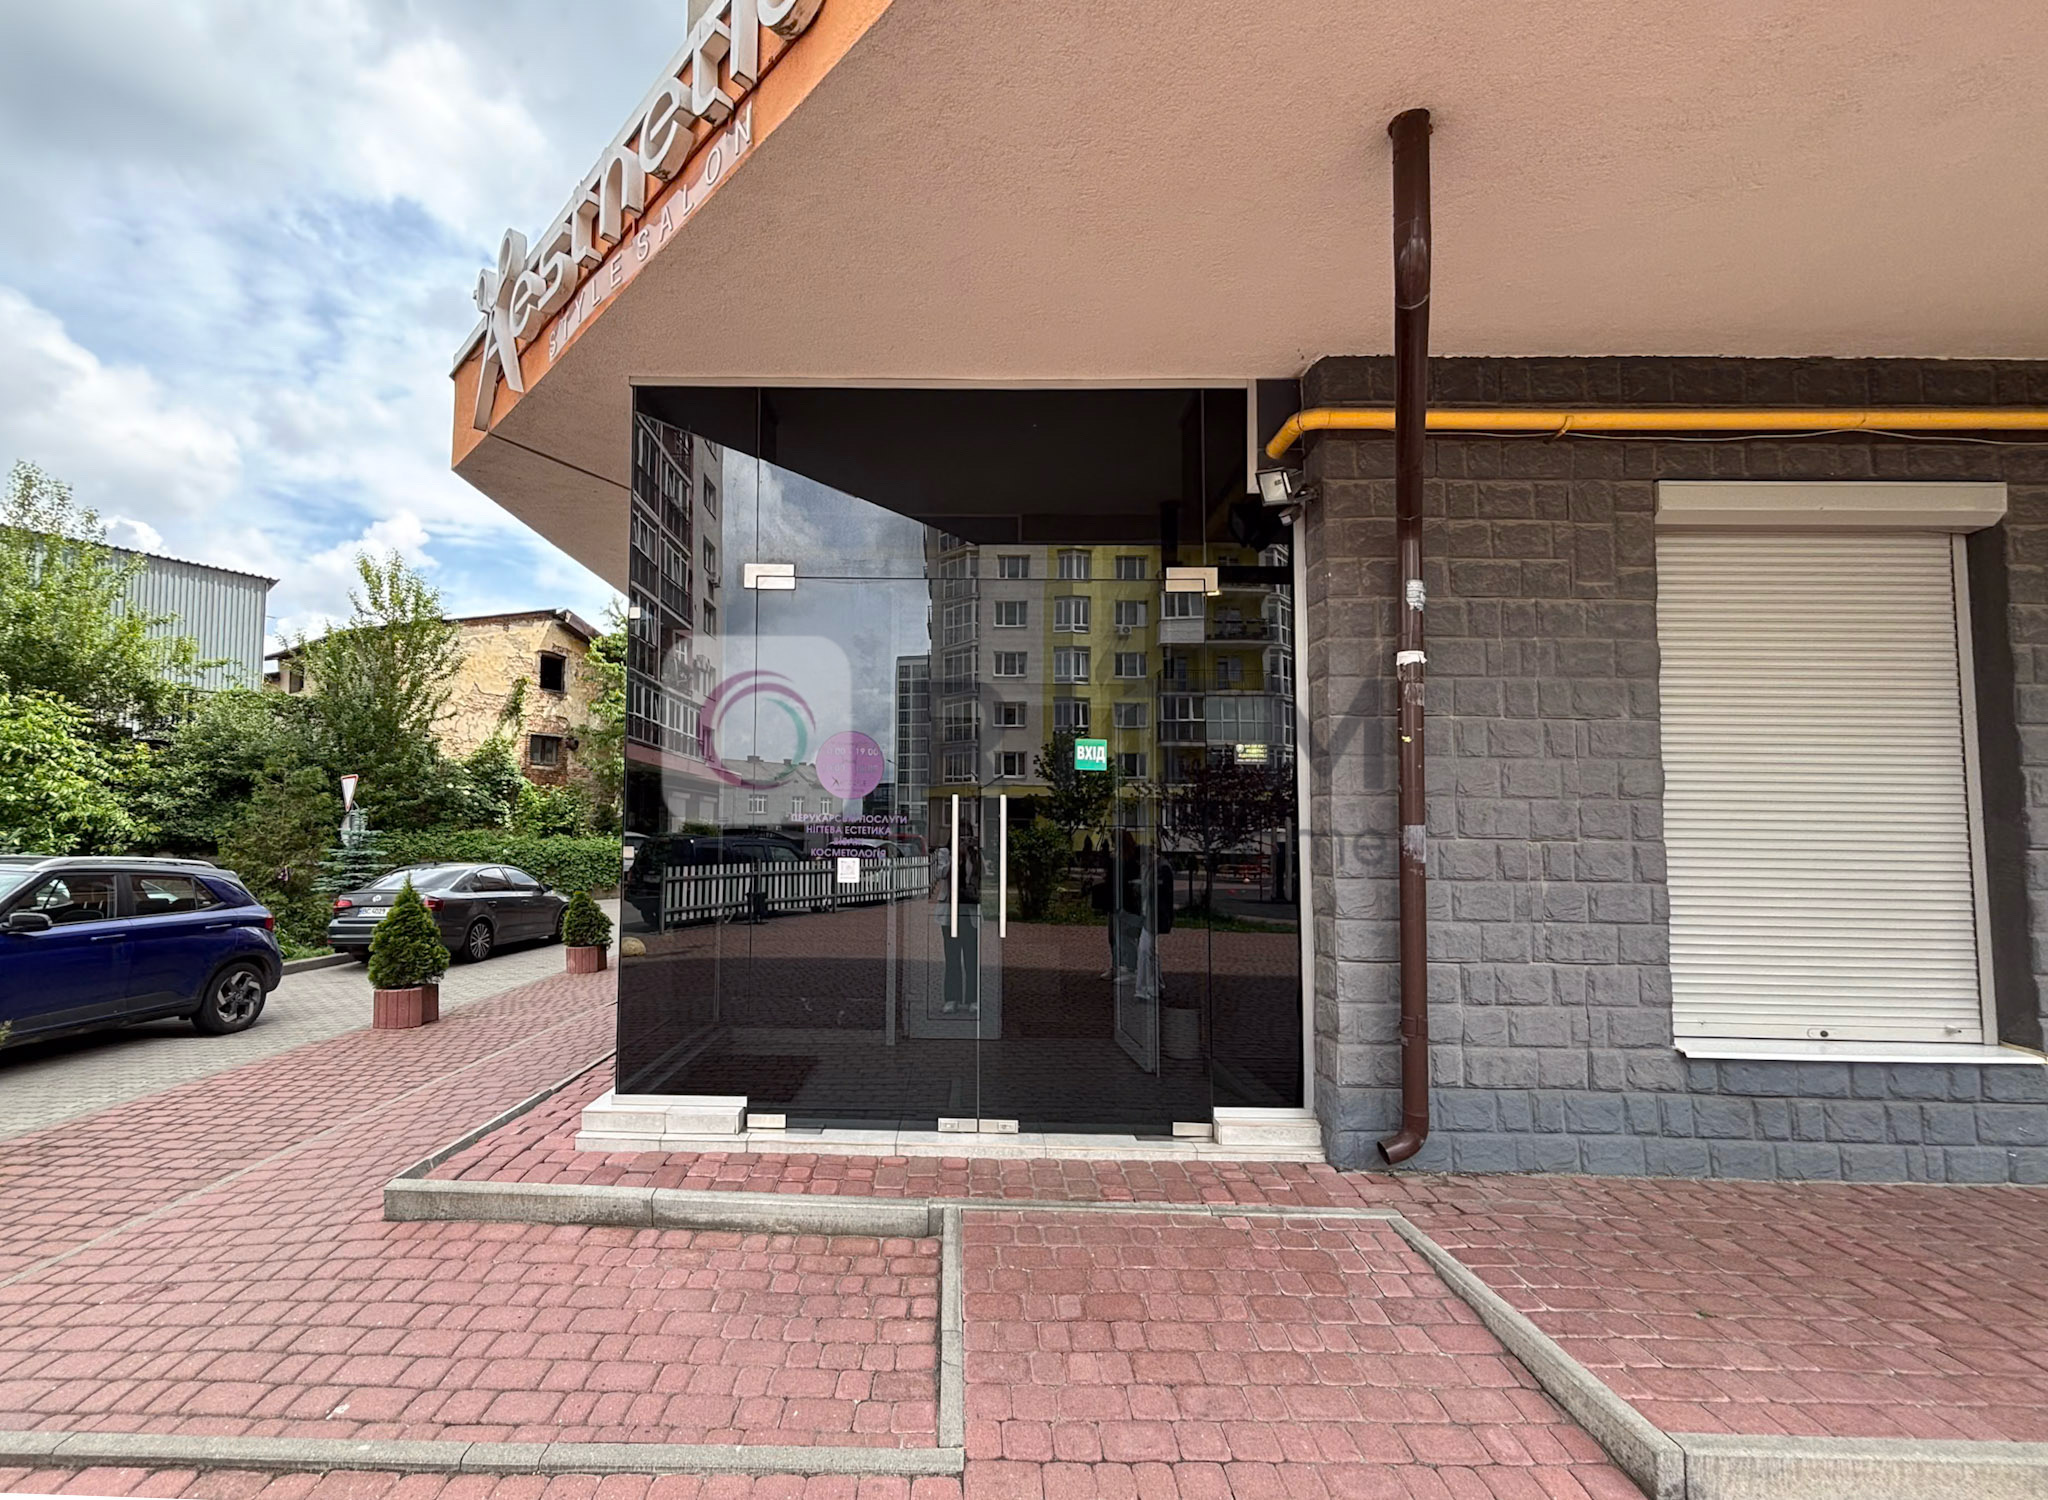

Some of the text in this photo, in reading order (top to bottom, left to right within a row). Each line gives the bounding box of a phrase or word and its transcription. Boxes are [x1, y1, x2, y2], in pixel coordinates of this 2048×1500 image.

[548, 99, 754, 357] STYLE SALON
[1077, 746, 1106, 764] ВХІД
[862, 814, 908, 824] ПОСЛУГИ
[845, 826, 892, 834] ЕСТЕТИКА
